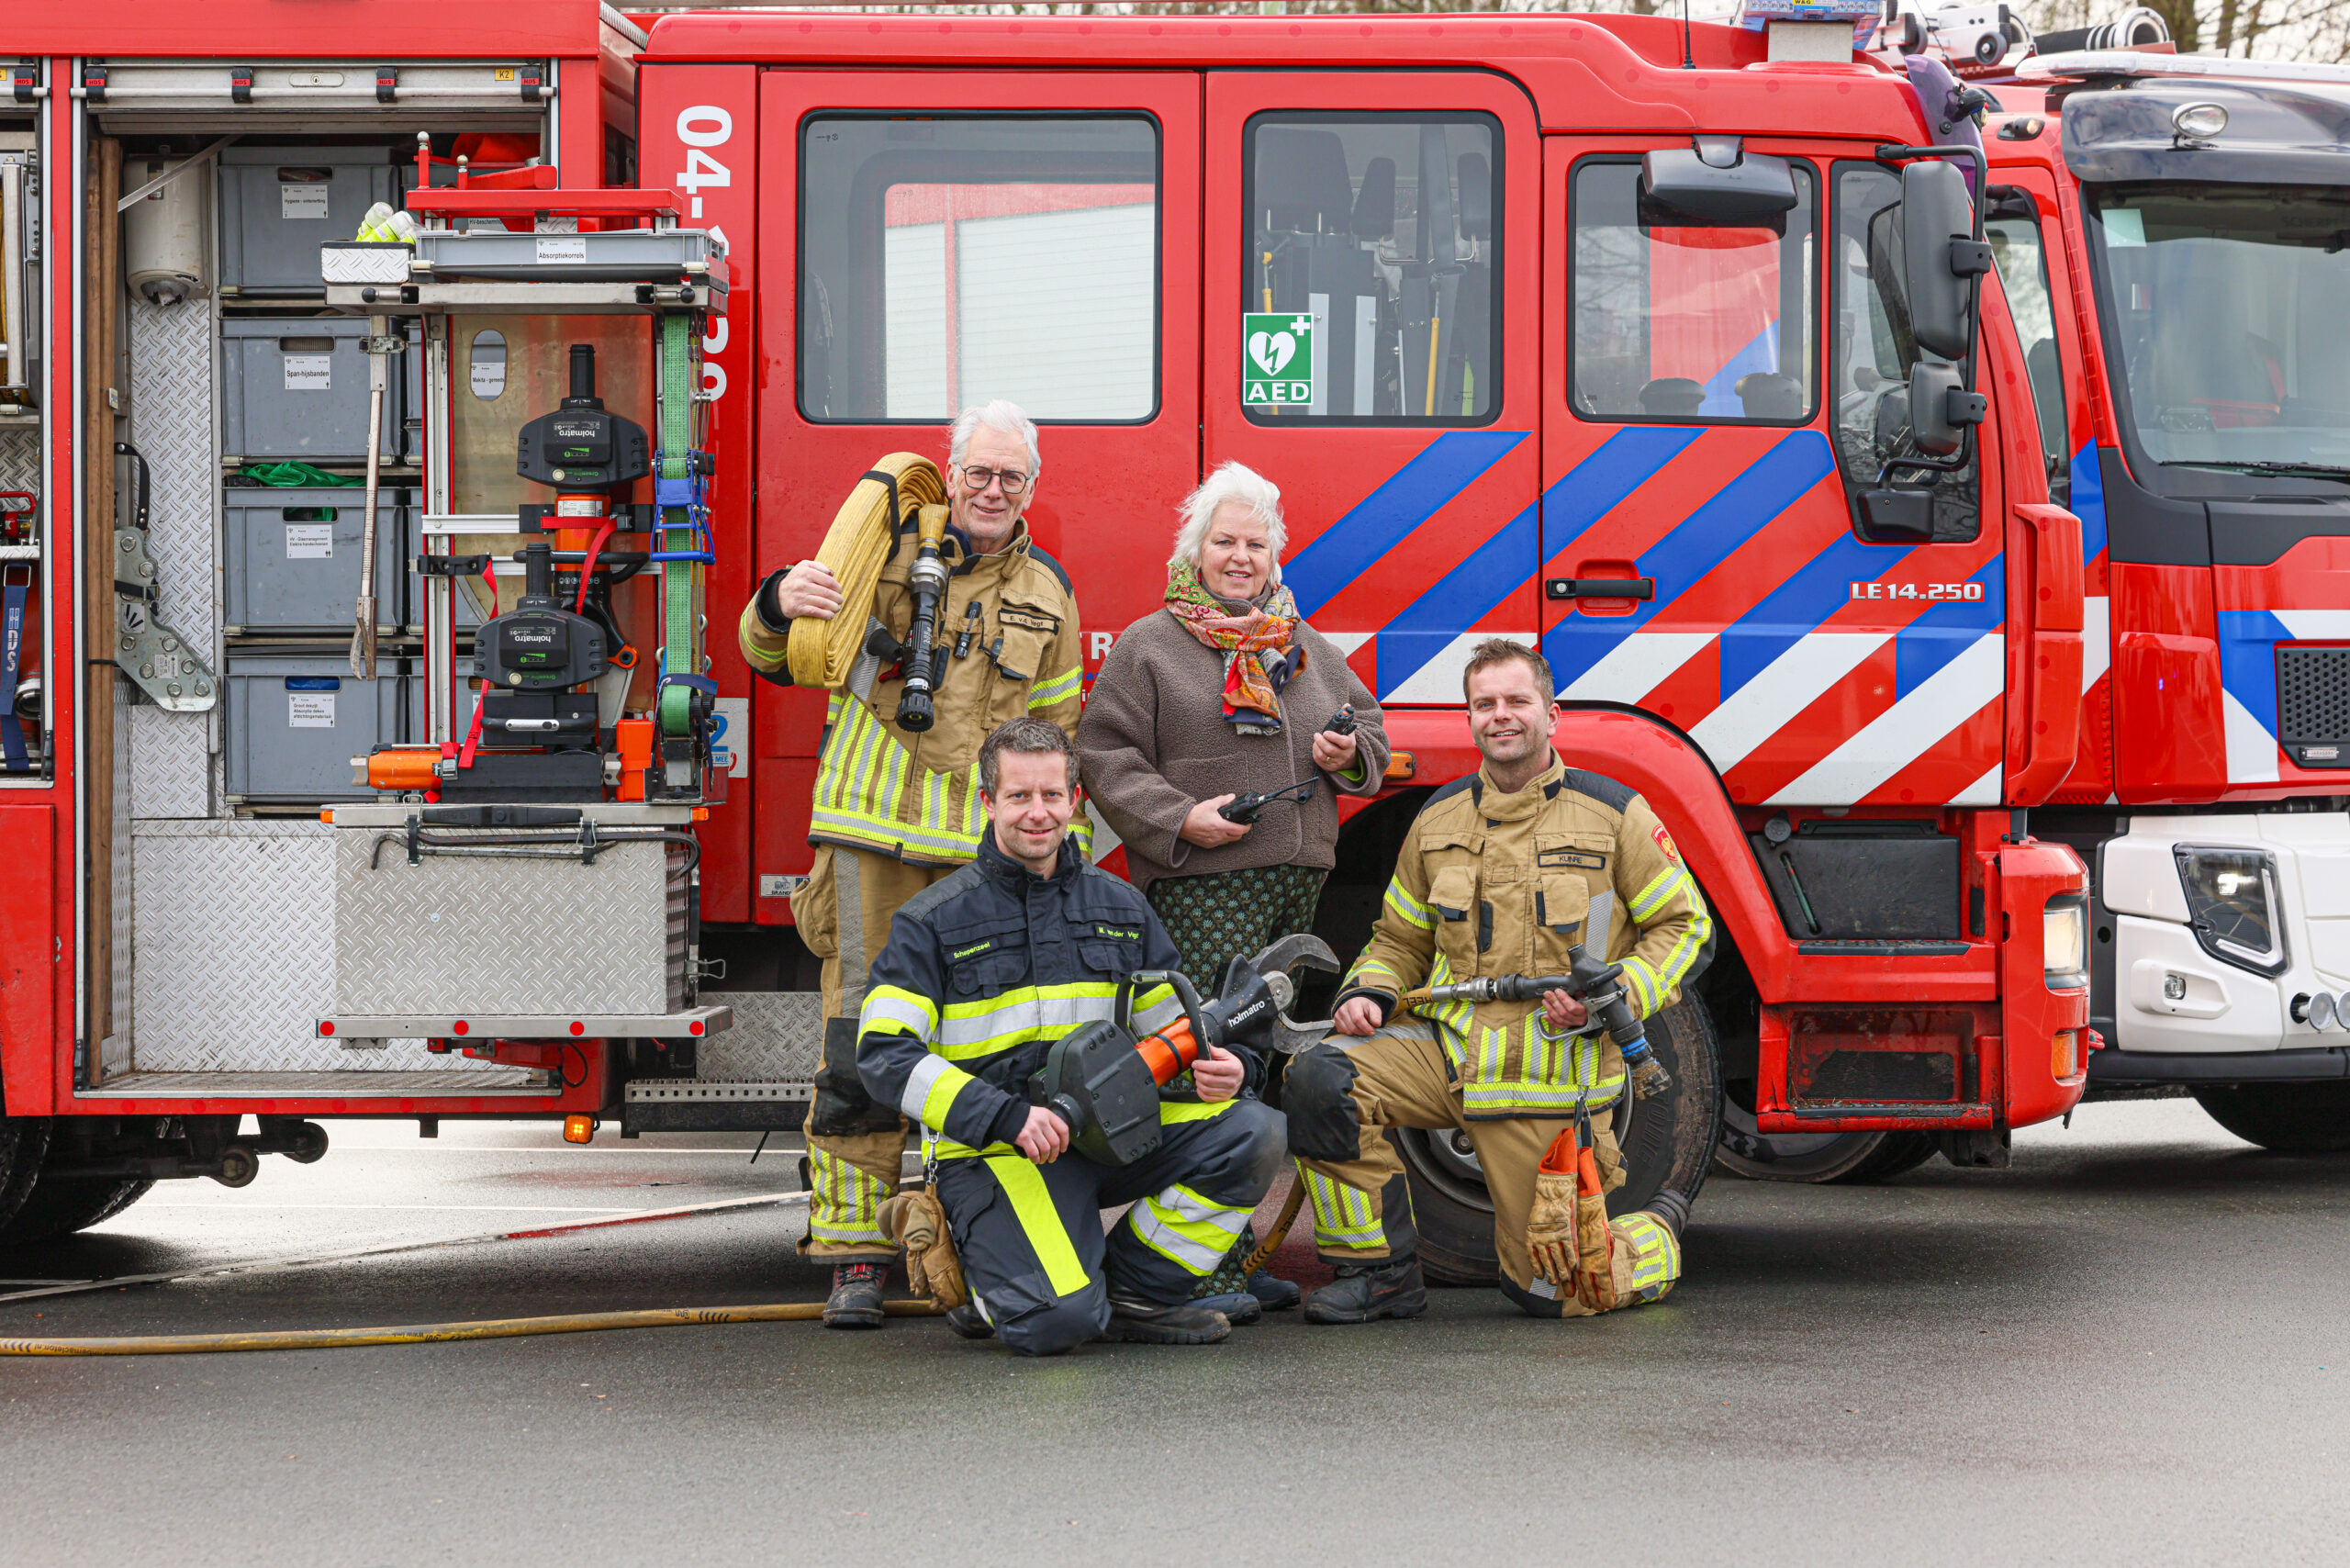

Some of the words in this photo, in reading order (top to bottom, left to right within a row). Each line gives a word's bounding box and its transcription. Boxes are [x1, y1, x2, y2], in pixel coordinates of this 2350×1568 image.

[499, 70, 509, 79] K2
[538, 252, 585, 260] Absorptiekorrels
[286, 369, 330, 378] Span-hijsbanden
[1247, 382, 1309, 401] AED
[558, 430, 595, 438] holmatro
[1852, 583, 1882, 599] LE
[1887, 583, 1982, 600] 14.250
[6, 608, 19, 672] HDS
[514, 635, 551, 644] holmatro
[1227, 1001, 1266, 1027] holmatro
